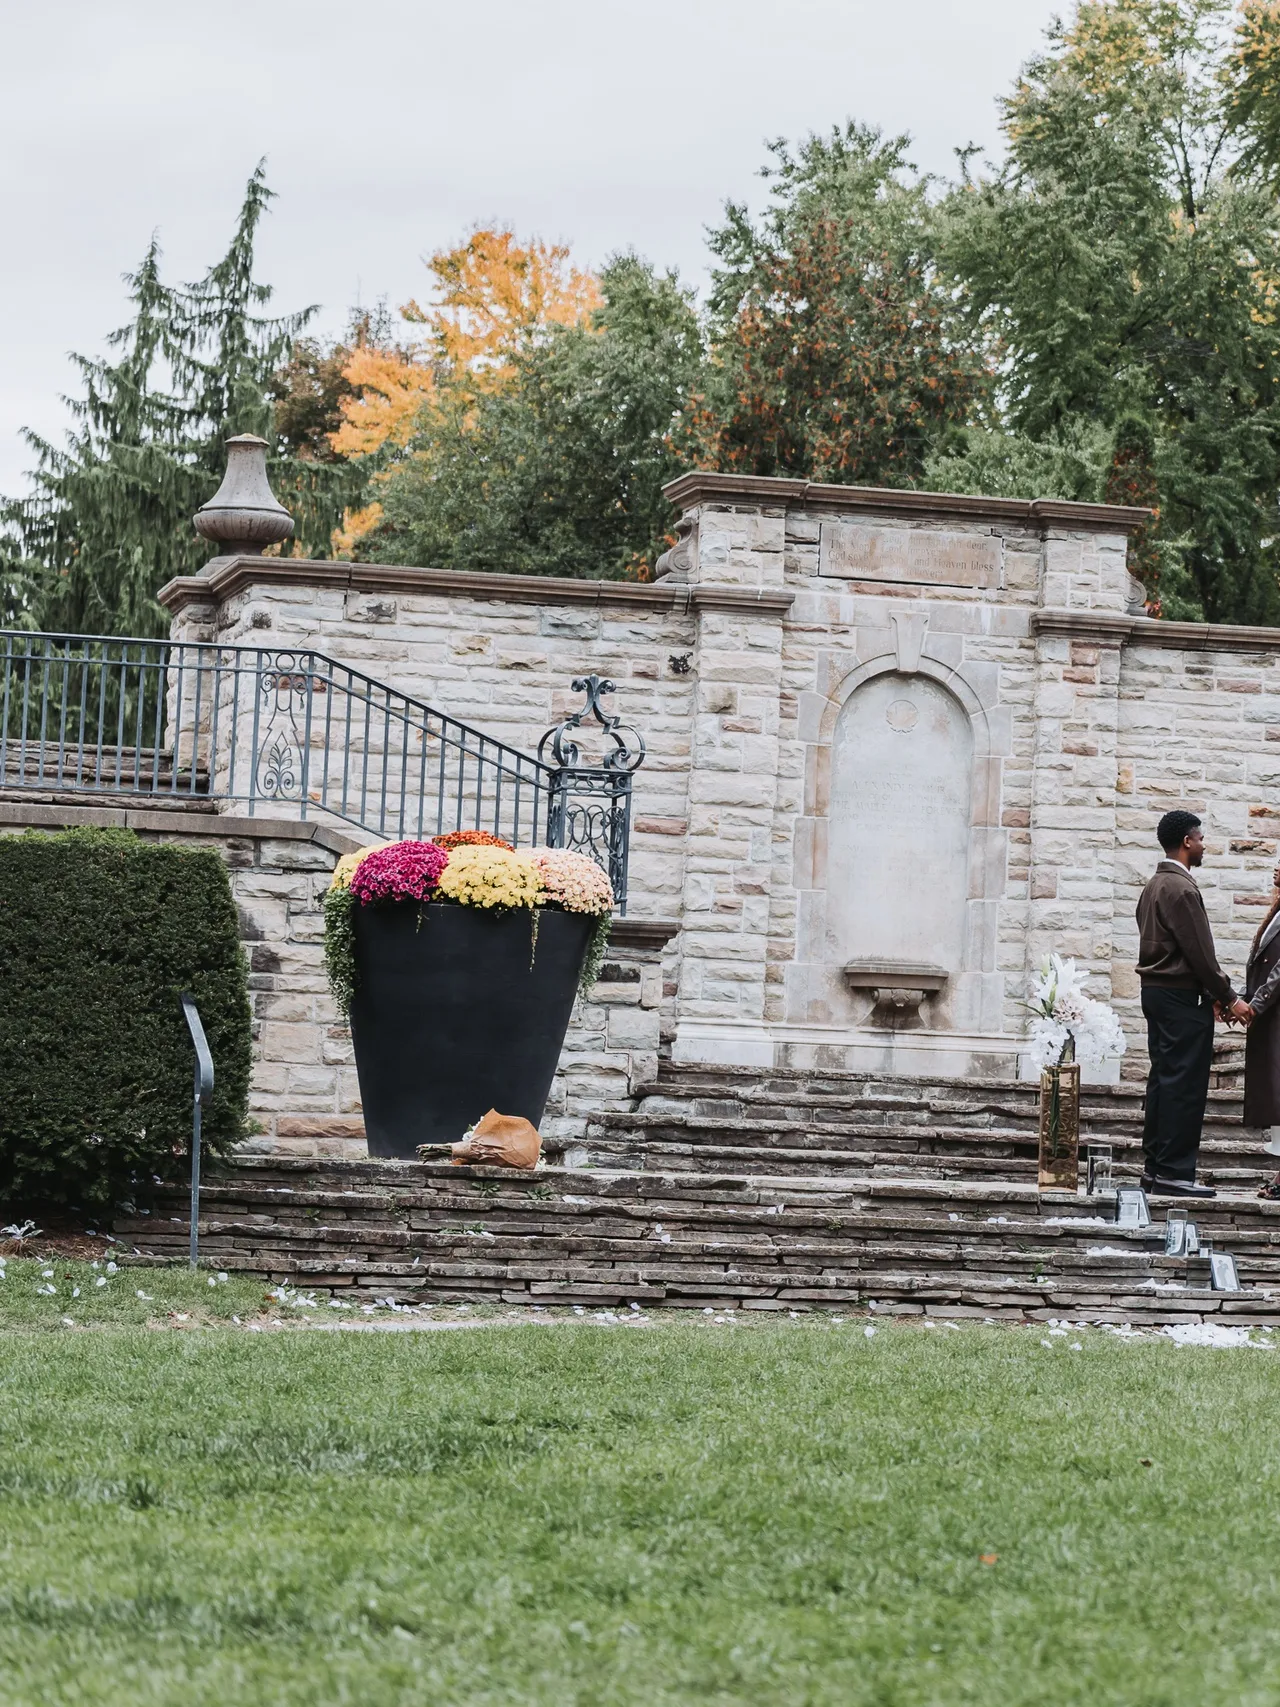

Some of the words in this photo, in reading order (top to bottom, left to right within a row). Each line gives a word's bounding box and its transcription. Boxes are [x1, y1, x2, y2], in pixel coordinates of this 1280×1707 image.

[828, 539, 845, 549] The
[828, 550, 845, 560] God
[914, 556, 929, 566] and
[934, 558, 966, 569] Heaven
